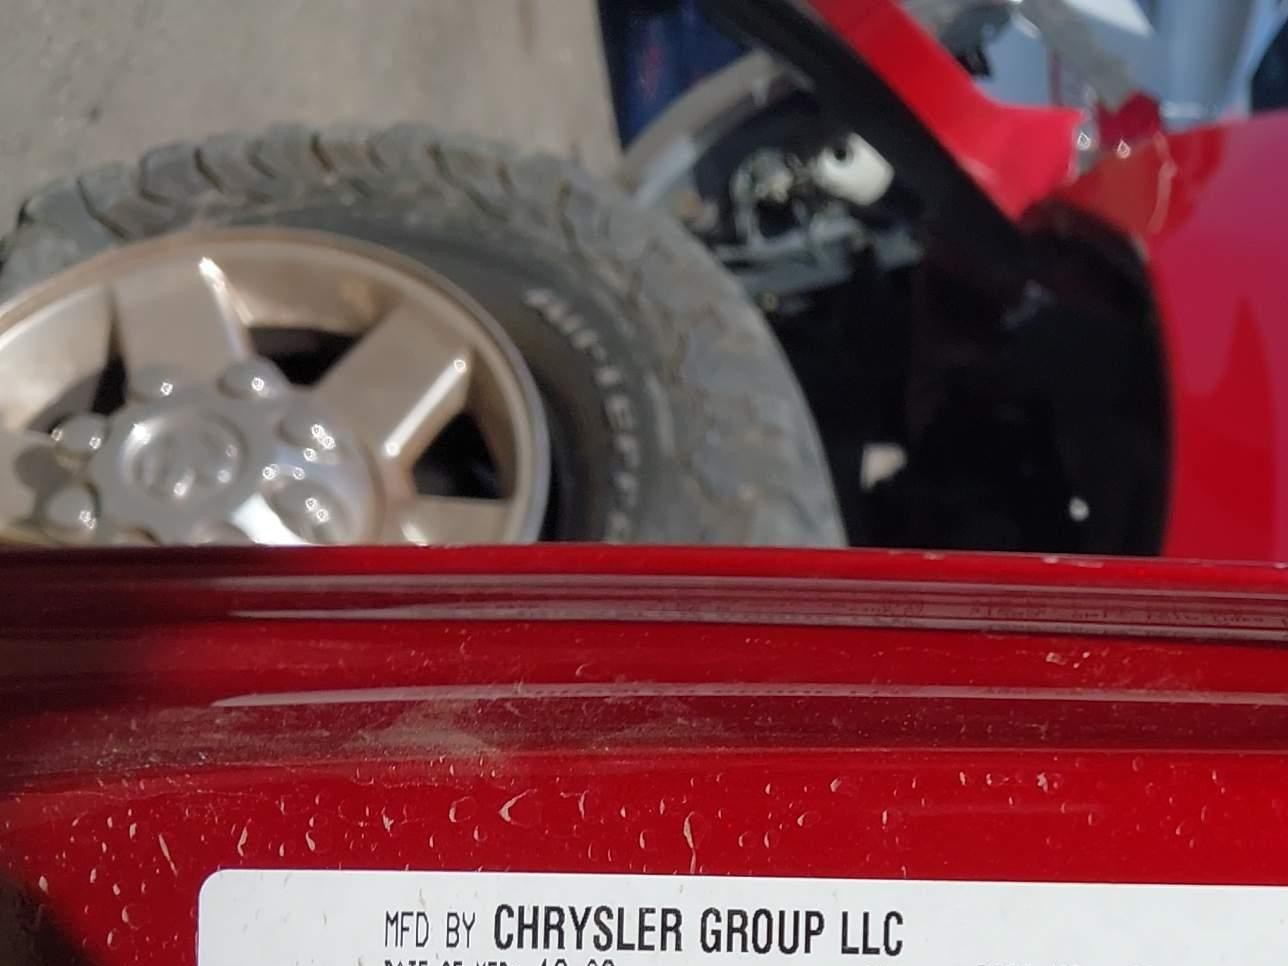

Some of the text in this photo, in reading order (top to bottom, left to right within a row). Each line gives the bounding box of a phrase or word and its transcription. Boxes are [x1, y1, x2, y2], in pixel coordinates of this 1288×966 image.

[385, 904, 903, 956] MFD BY CHRYSLER GROUP LLC
